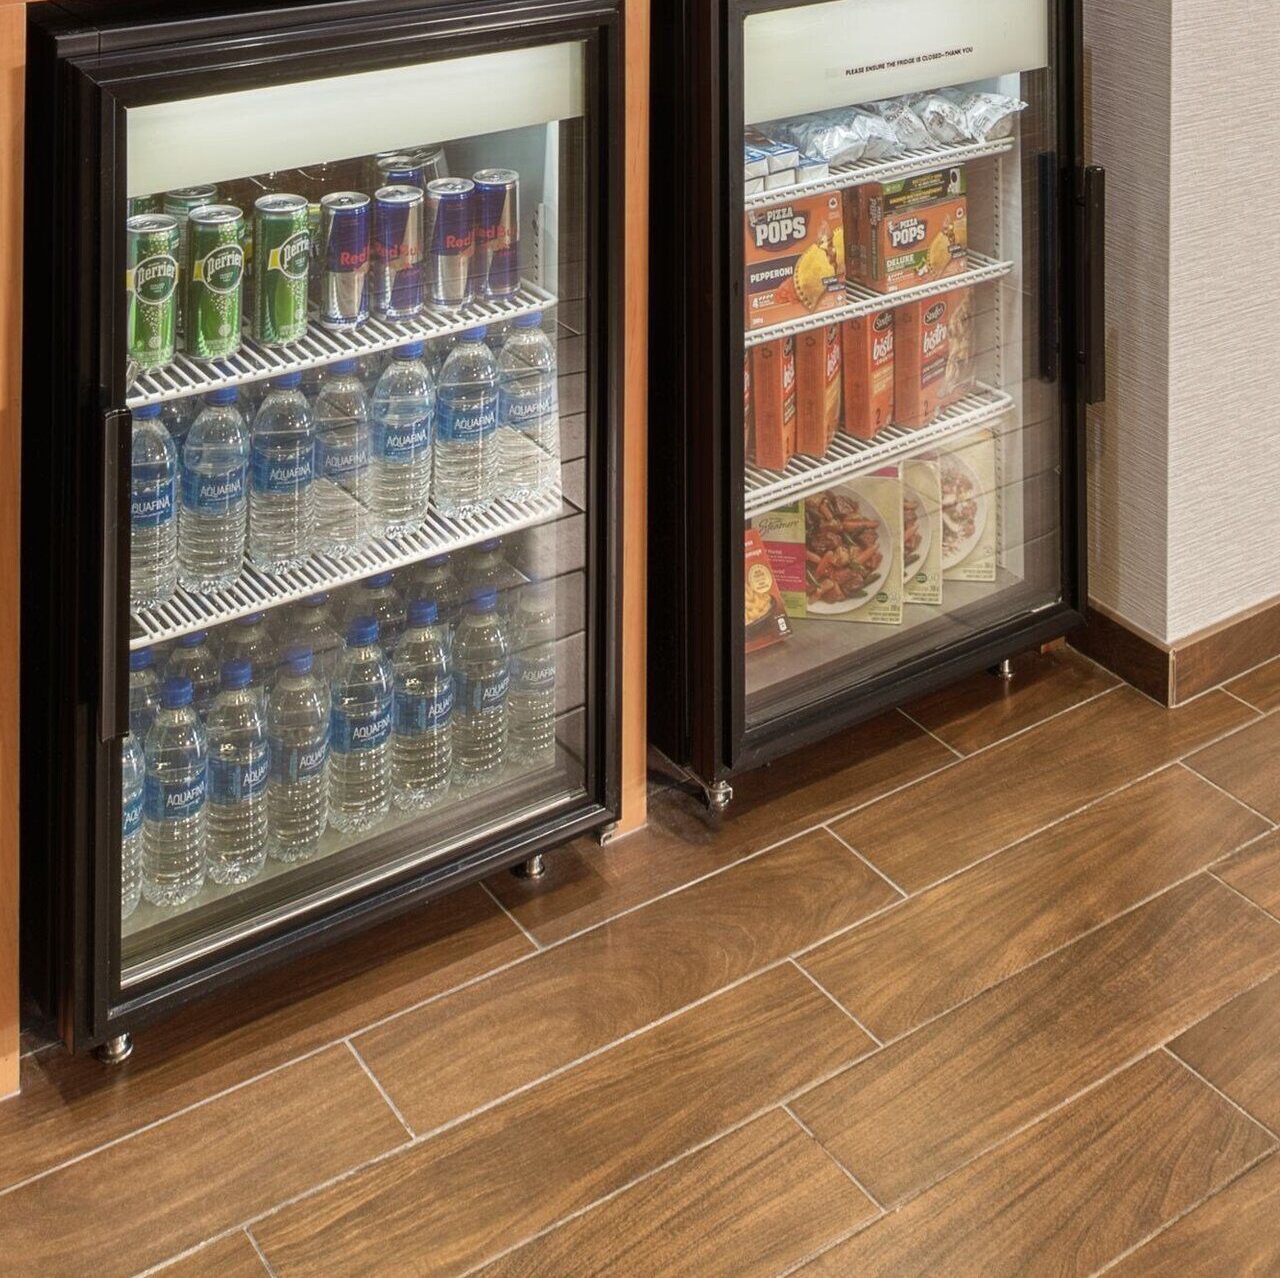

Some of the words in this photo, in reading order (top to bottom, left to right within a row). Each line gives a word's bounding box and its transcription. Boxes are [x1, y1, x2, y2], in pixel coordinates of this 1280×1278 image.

[846, 66, 864, 76] PLEASE
[865, 63, 885, 72] ENSURE
[886, 61, 896, 70] THE
[896, 58, 915, 66] FRIDGE
[962, 46, 974, 54] YOU
[766, 208, 794, 222] PIZZA
[756, 216, 806, 248] POPS
[892, 226, 926, 248] POPS
[340, 250, 366, 266] Red
[886, 255, 915, 268] DELUXE
[207, 254, 242, 282] Perrier
[750, 266, 793, 284] PEPPERONI
[137, 264, 175, 293] Perrier
[923, 324, 948, 353] bistro
[509, 400, 550, 416] AQUAFINA
[454, 412, 495, 430] AQUAFINA
[386, 430, 428, 448] AQUAFINA
[324, 452, 368, 468] AQUAFINA
[269, 463, 311, 482] AQUAFINA
[200, 480, 242, 498] AQUAFINA
[132, 496, 170, 515] QUAFINA
